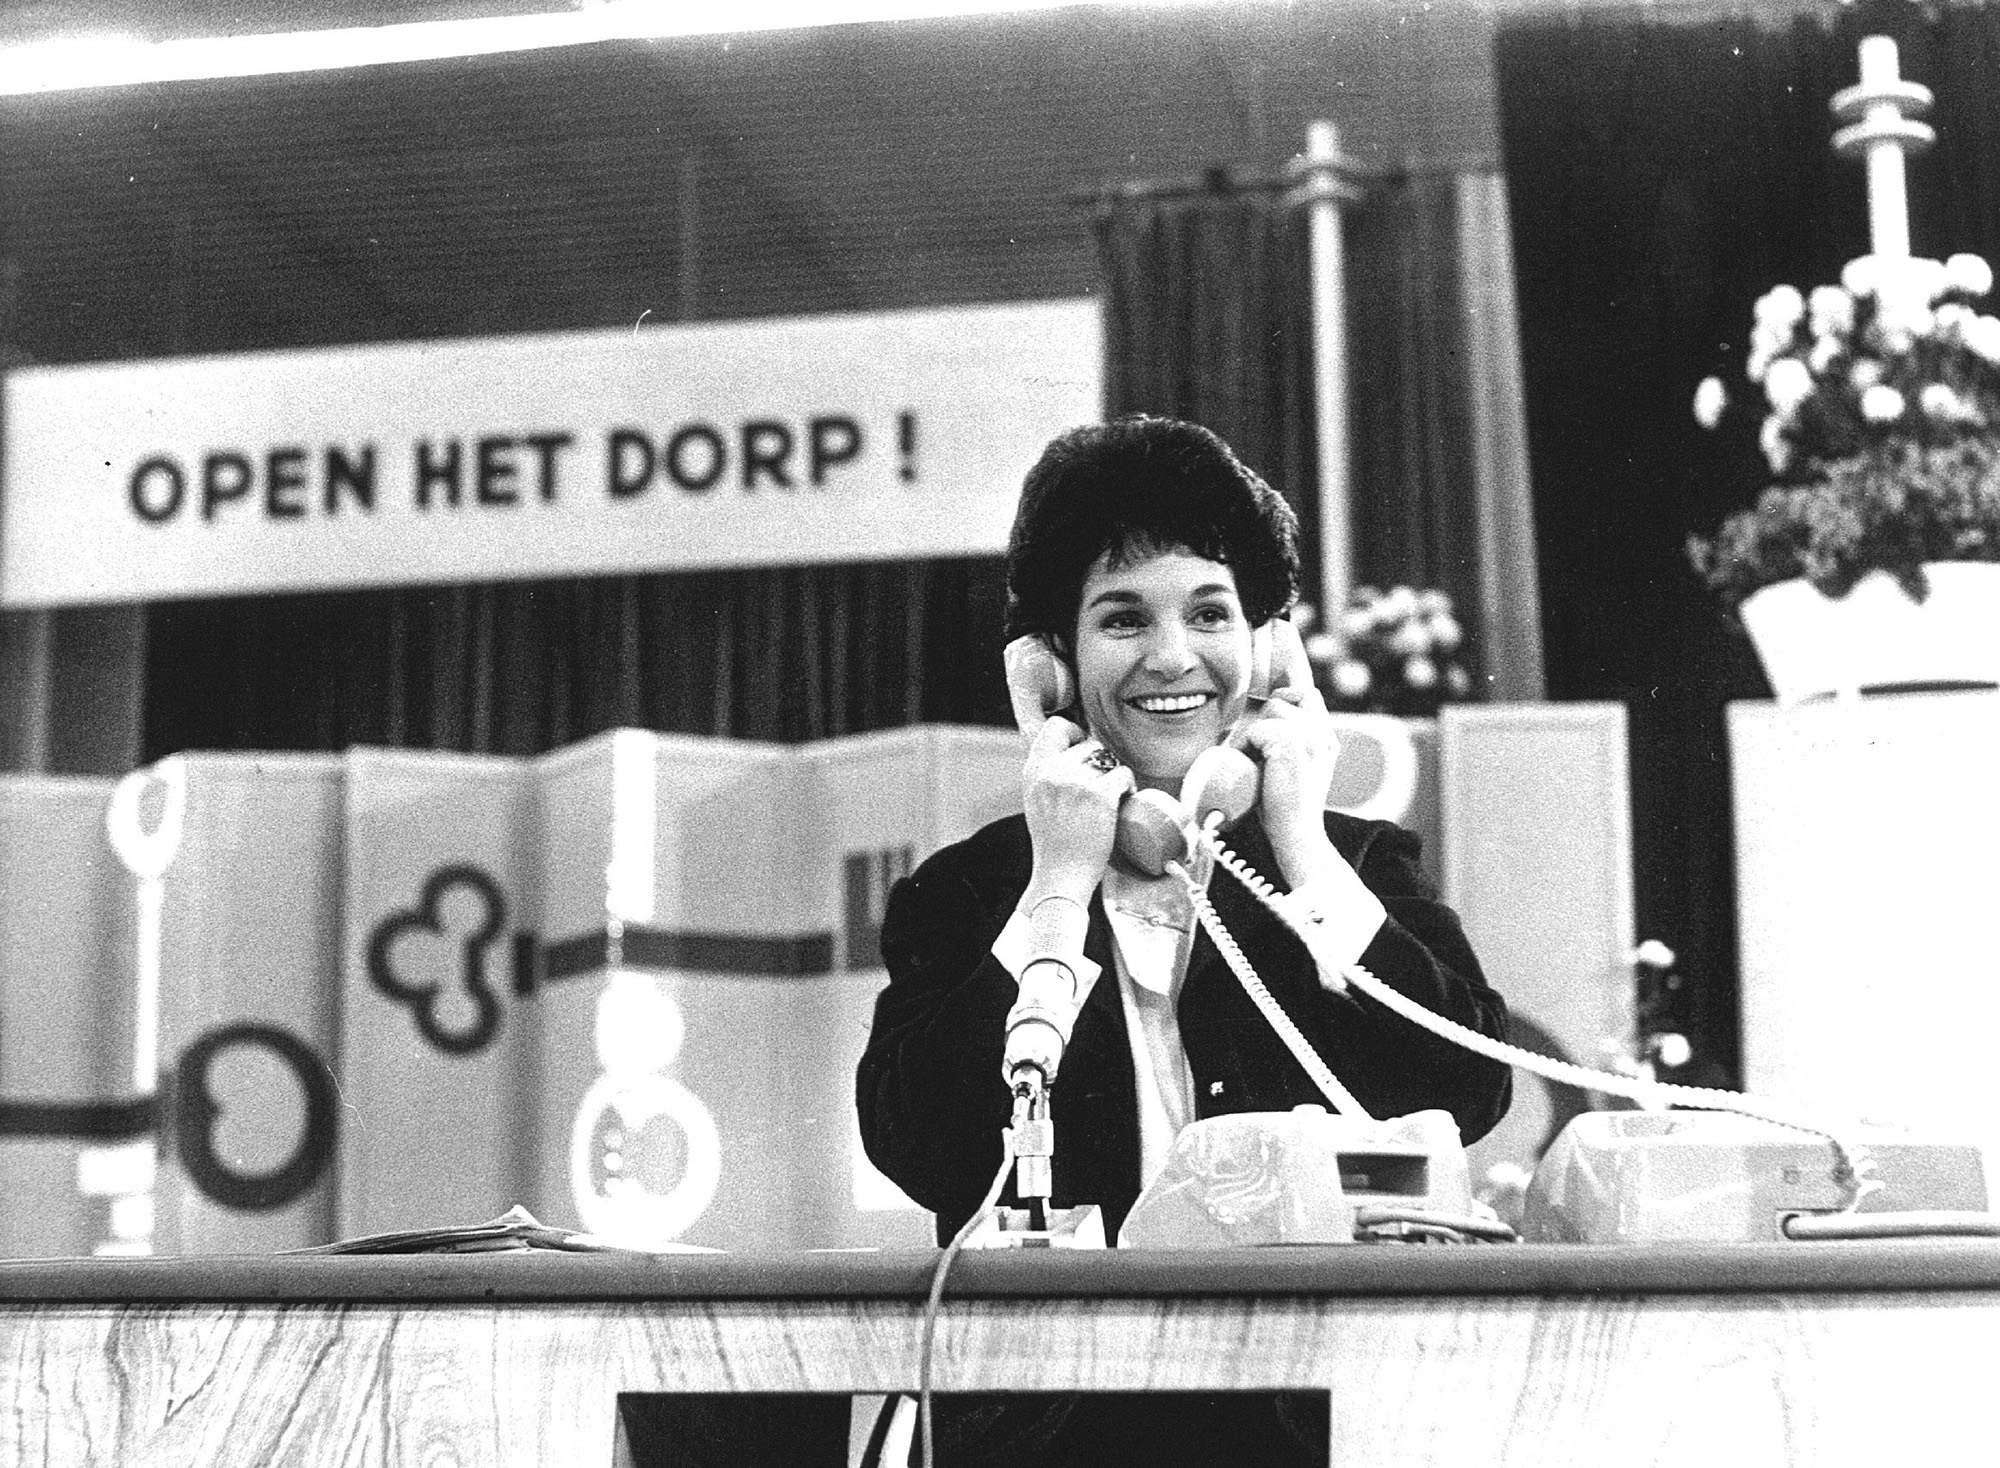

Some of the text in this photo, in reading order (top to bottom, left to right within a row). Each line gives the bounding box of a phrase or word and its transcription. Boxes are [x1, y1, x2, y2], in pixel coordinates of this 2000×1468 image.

[128, 446, 378, 523] OPEN
[414, 431, 573, 508] HET
[606, 414, 865, 501] DORP
